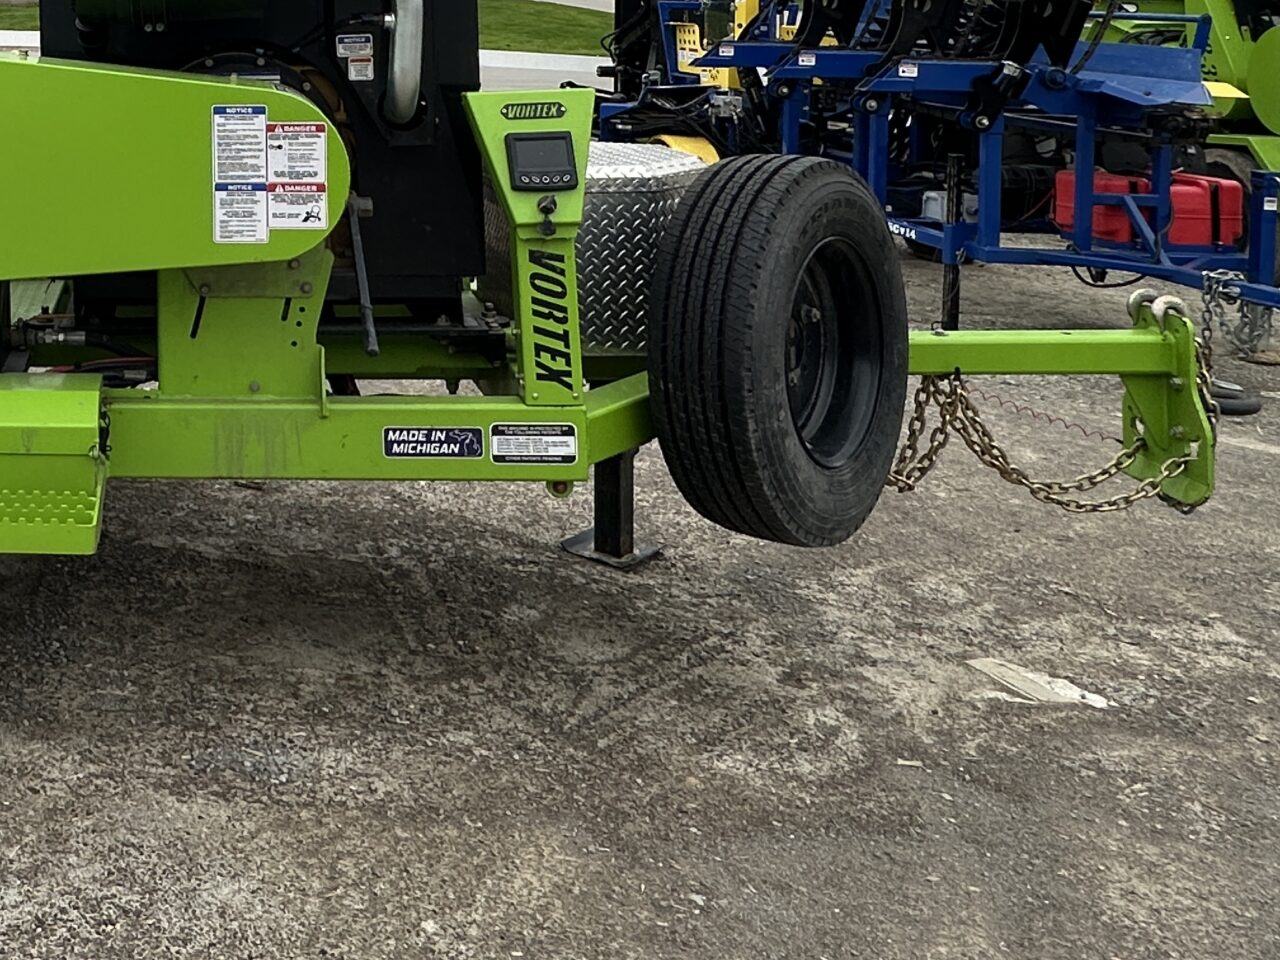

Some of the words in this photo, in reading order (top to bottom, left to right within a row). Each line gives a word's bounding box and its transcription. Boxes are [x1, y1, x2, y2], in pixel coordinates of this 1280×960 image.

[506, 103, 559, 119] VORTEX
[528, 249, 574, 393] VORTEX
[387, 430, 428, 441] MADE
[431, 430, 446, 441] IN
[392, 443, 460, 454] MICHIGAN
